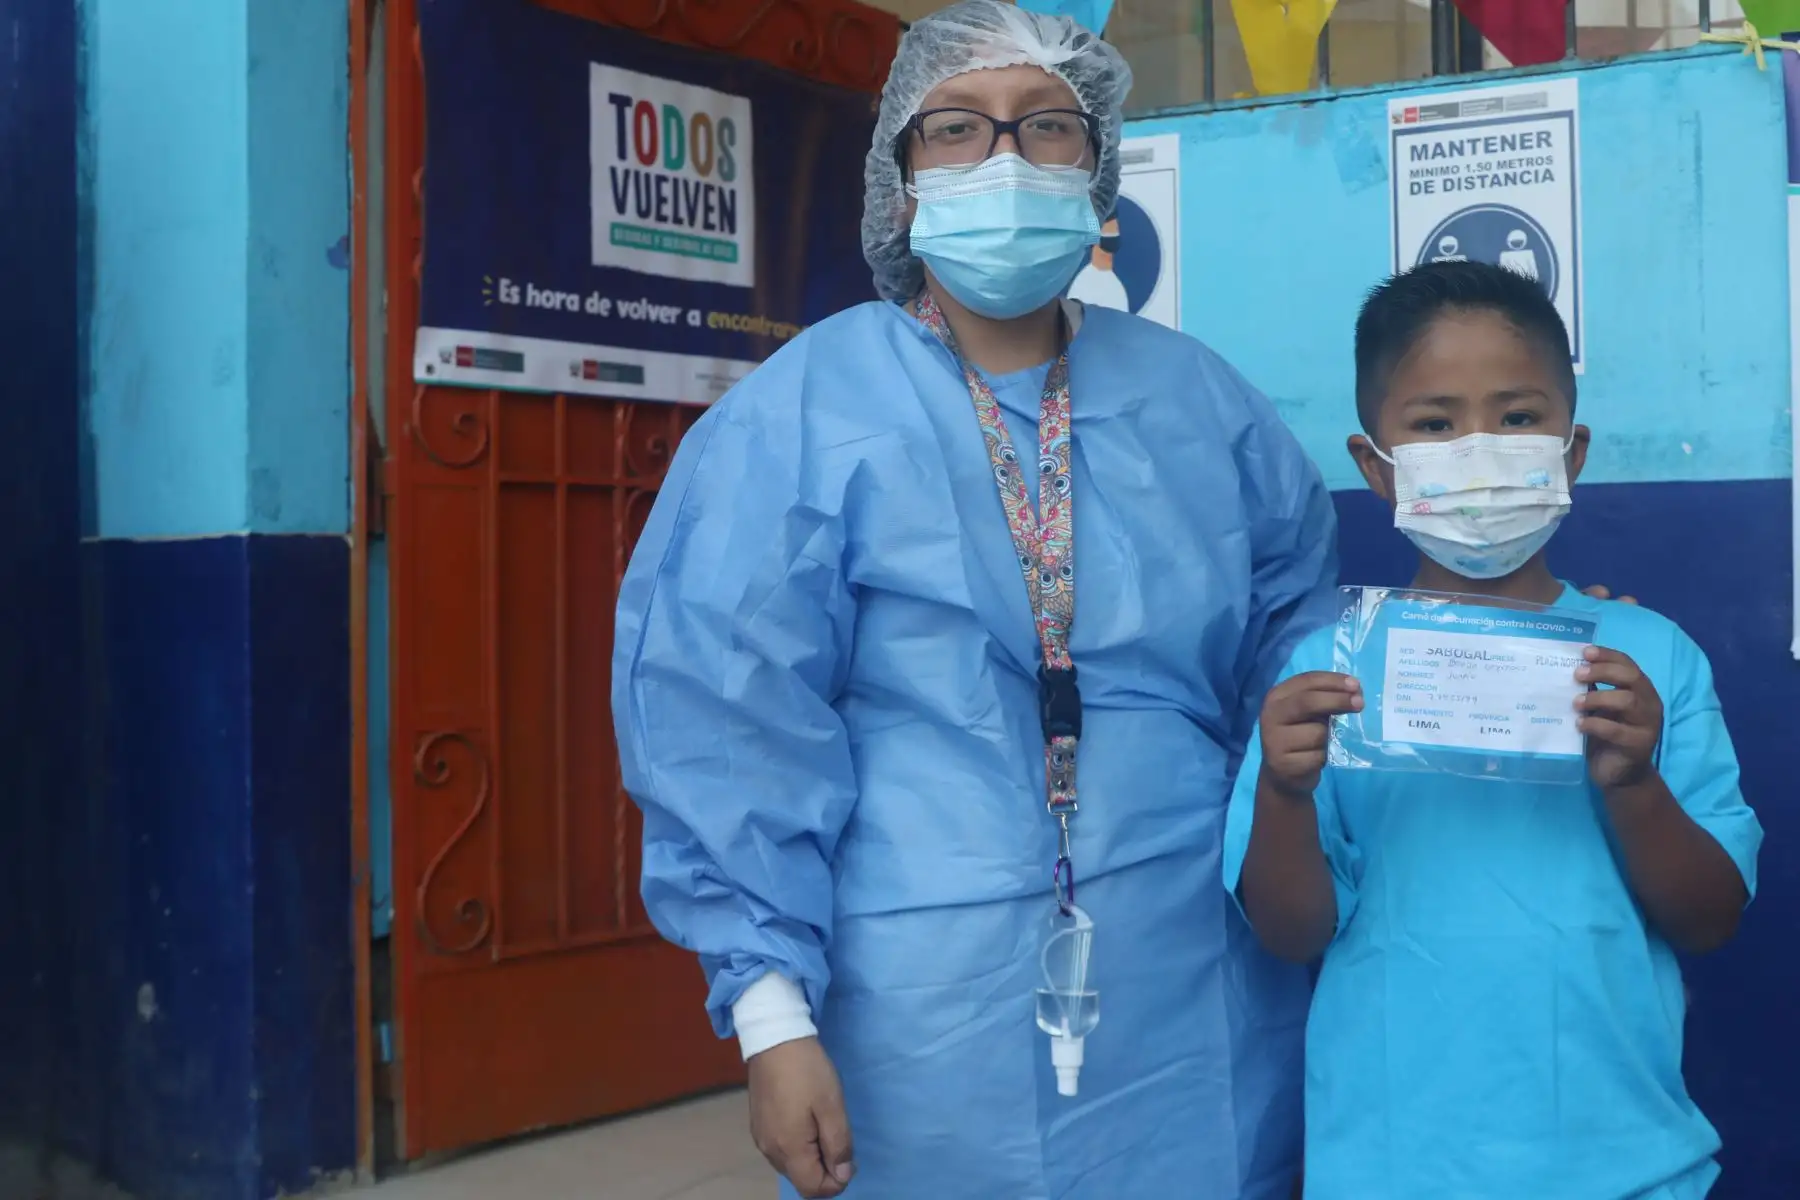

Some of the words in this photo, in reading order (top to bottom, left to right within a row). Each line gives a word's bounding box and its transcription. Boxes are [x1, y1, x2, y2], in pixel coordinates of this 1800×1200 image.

[608, 92, 736, 182] TODOS
[1409, 130, 1553, 163] MANTENER
[1464, 161, 1492, 173] 1.50
[1496, 155, 1553, 170] METROS
[1409, 179, 1435, 195] DE
[1443, 168, 1555, 193] DISTANCIA
[609, 165, 737, 235] VUELVEN
[499, 278, 521, 304] Es
[526, 283, 580, 312] hora
[584, 290, 612, 317] de
[616, 297, 683, 324] volver
[686, 308, 701, 327] a
[1495, 619, 1525, 629] contra
[1536, 622, 1566, 632] COVID
[1573, 626, 1584, 635] 19
[1425, 647, 1491, 661] SABOGAL
[1408, 719, 1441, 730] LIMA
